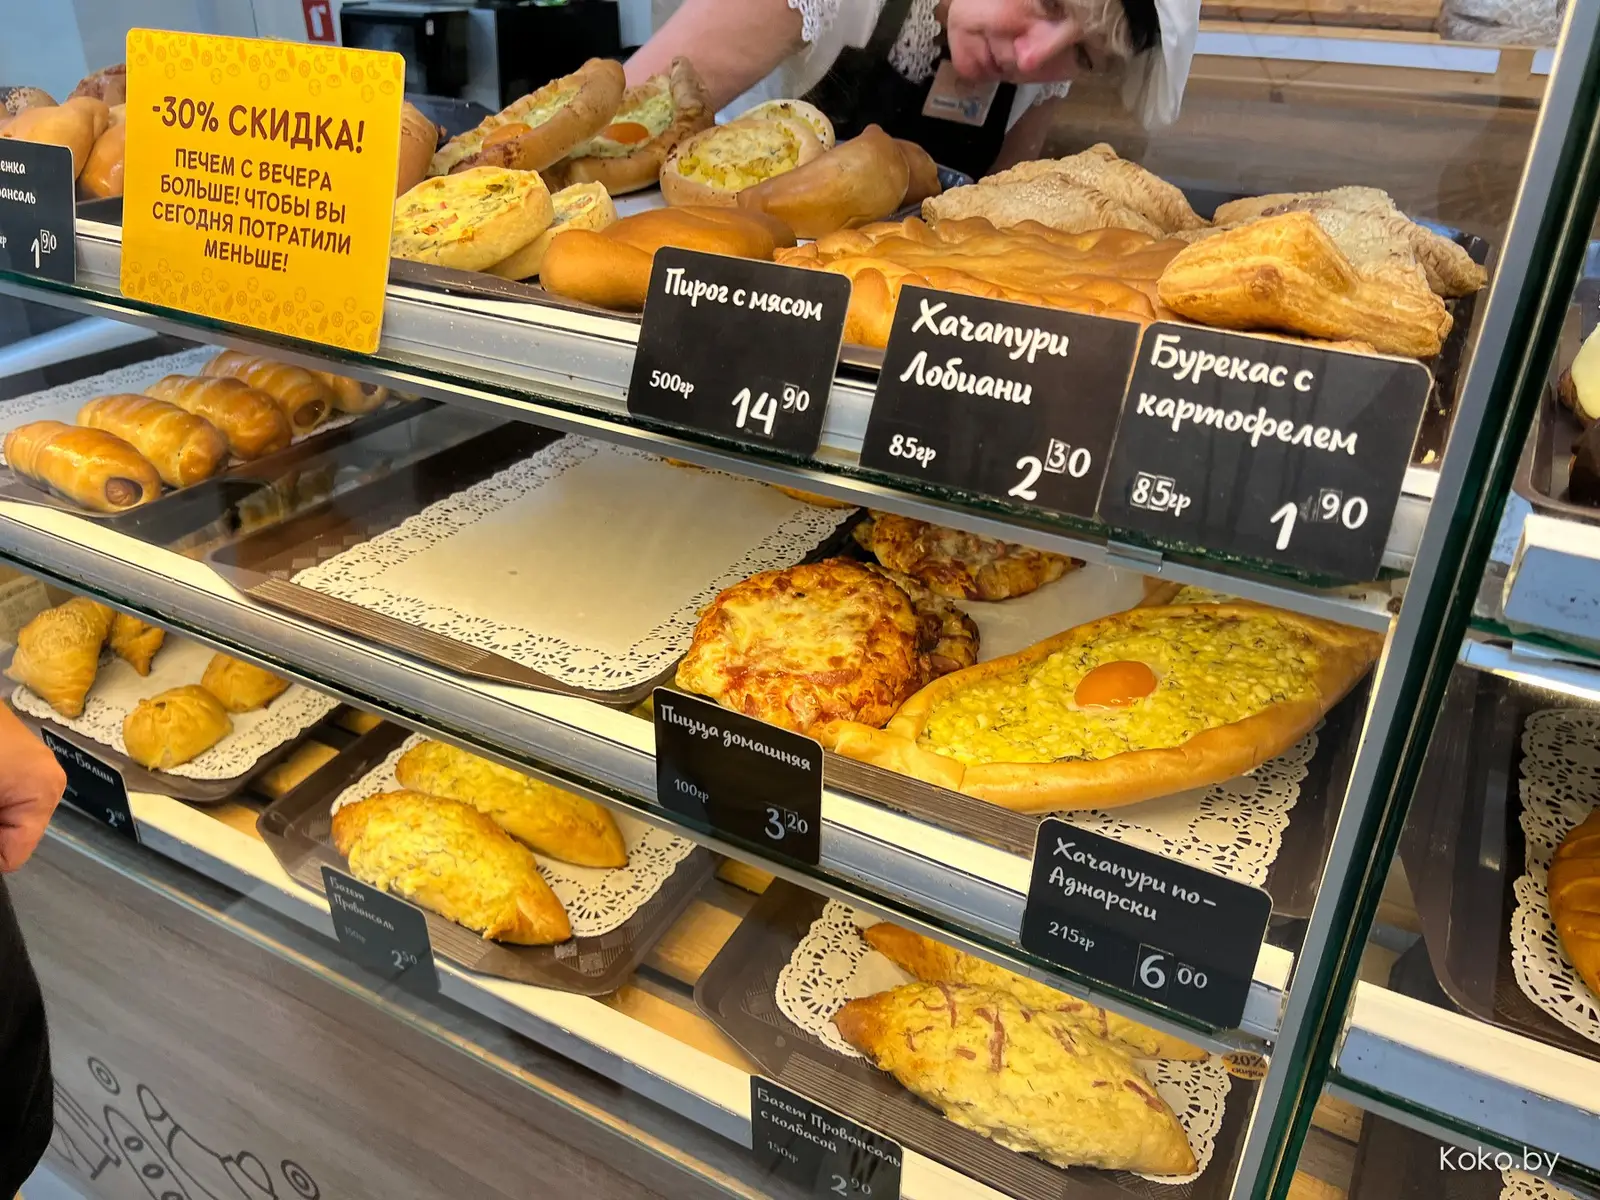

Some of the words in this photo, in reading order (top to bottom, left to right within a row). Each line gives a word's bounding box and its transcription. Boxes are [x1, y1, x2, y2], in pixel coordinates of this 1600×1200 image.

[152, 96, 219, 132] -30%
[228, 104, 365, 153] СКИДКА!
[0, 158, 26, 175] ежка
[175, 148, 236, 176] ПЕЧЕМ
[240, 159, 254, 178] С
[258, 162, 332, 192] ВЕЧЕРА
[160, 175, 239, 205] БОЛЬШЕ!
[244, 187, 310, 218] ЧТОБЫ
[315, 200, 346, 224] ВЫ
[152, 202, 233, 234] СЕГОДНЯ
[239, 217, 351, 255] ПОТРАТИЛИ
[204, 239, 288, 273] МЕНЬШЕ!
[664, 268, 729, 308] Пирог
[733, 288, 746, 306] с
[749, 291, 824, 322] мясом
[911, 298, 1069, 362] Хачапури
[649, 370, 695, 400] 500гр
[899, 352, 1033, 406] Лобиани
[1150, 333, 1289, 388] Бурекас
[1294, 366, 1313, 392] с
[1136, 391, 1359, 456] картофелем
[888, 433, 937, 468] 85гр
[1131, 476, 1192, 516] 85гр
[661, 704, 719, 739] Пицца
[722, 731, 811, 771] домашняя
[674, 778, 709, 803] 100гр
[329, 875, 365, 902] Багет
[1052, 837, 1166, 894] Хачапури
[333, 893, 395, 931] Провансаль
[1049, 866, 1157, 921] Аджарски
[1048, 921, 1095, 951] 215гр
[757, 1087, 807, 1121] Багет
[810, 1113, 901, 1168] Провансаль
[760, 1110, 769, 1120] с
[771, 1115, 838, 1154] колбасой
[767, 1141, 799, 1164] 150гр
